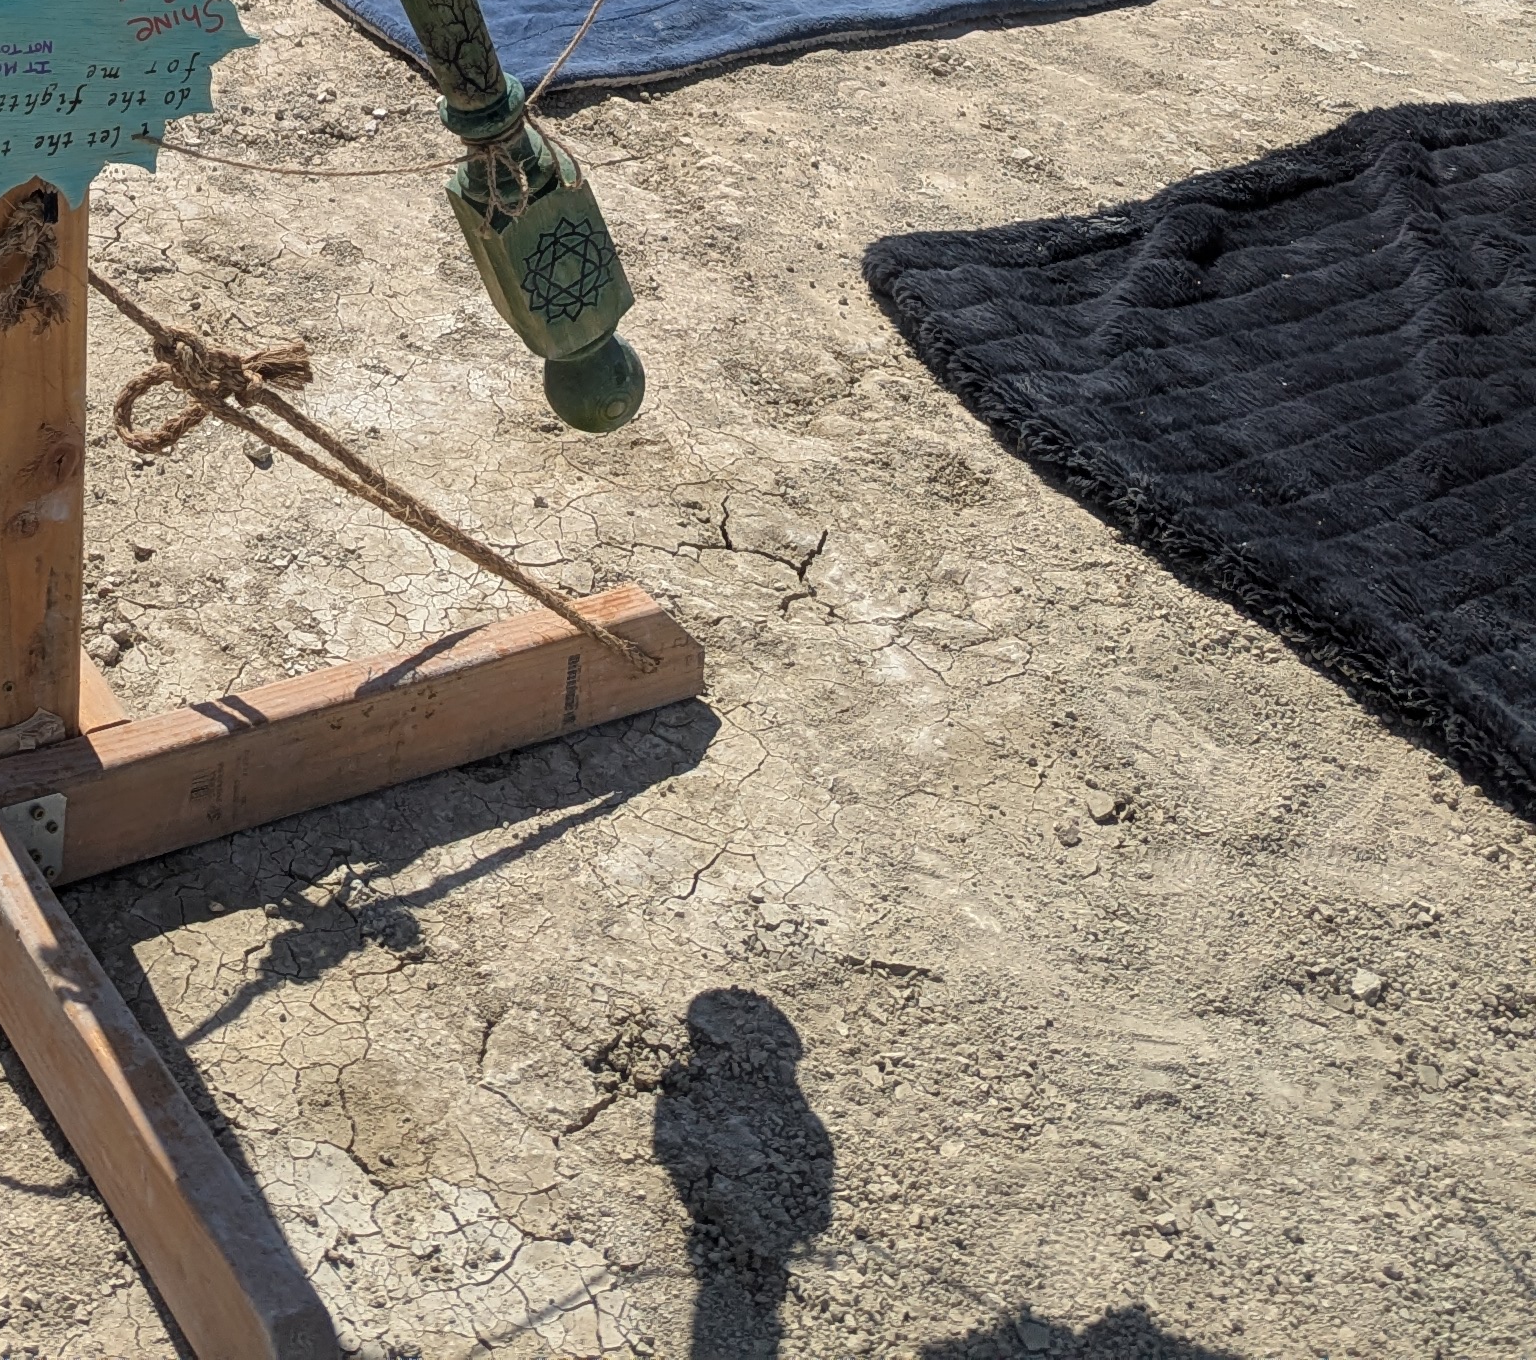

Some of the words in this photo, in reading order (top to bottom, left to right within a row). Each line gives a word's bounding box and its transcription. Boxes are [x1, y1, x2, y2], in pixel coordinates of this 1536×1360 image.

[23, 60, 52, 73] IT
[87, 64, 120, 80] me
[145, 52, 201, 82] for
[108, 88, 146, 109] the
[165, 86, 191, 110] do
[34, 135, 73, 156] the
[86, 127, 119, 145] let
